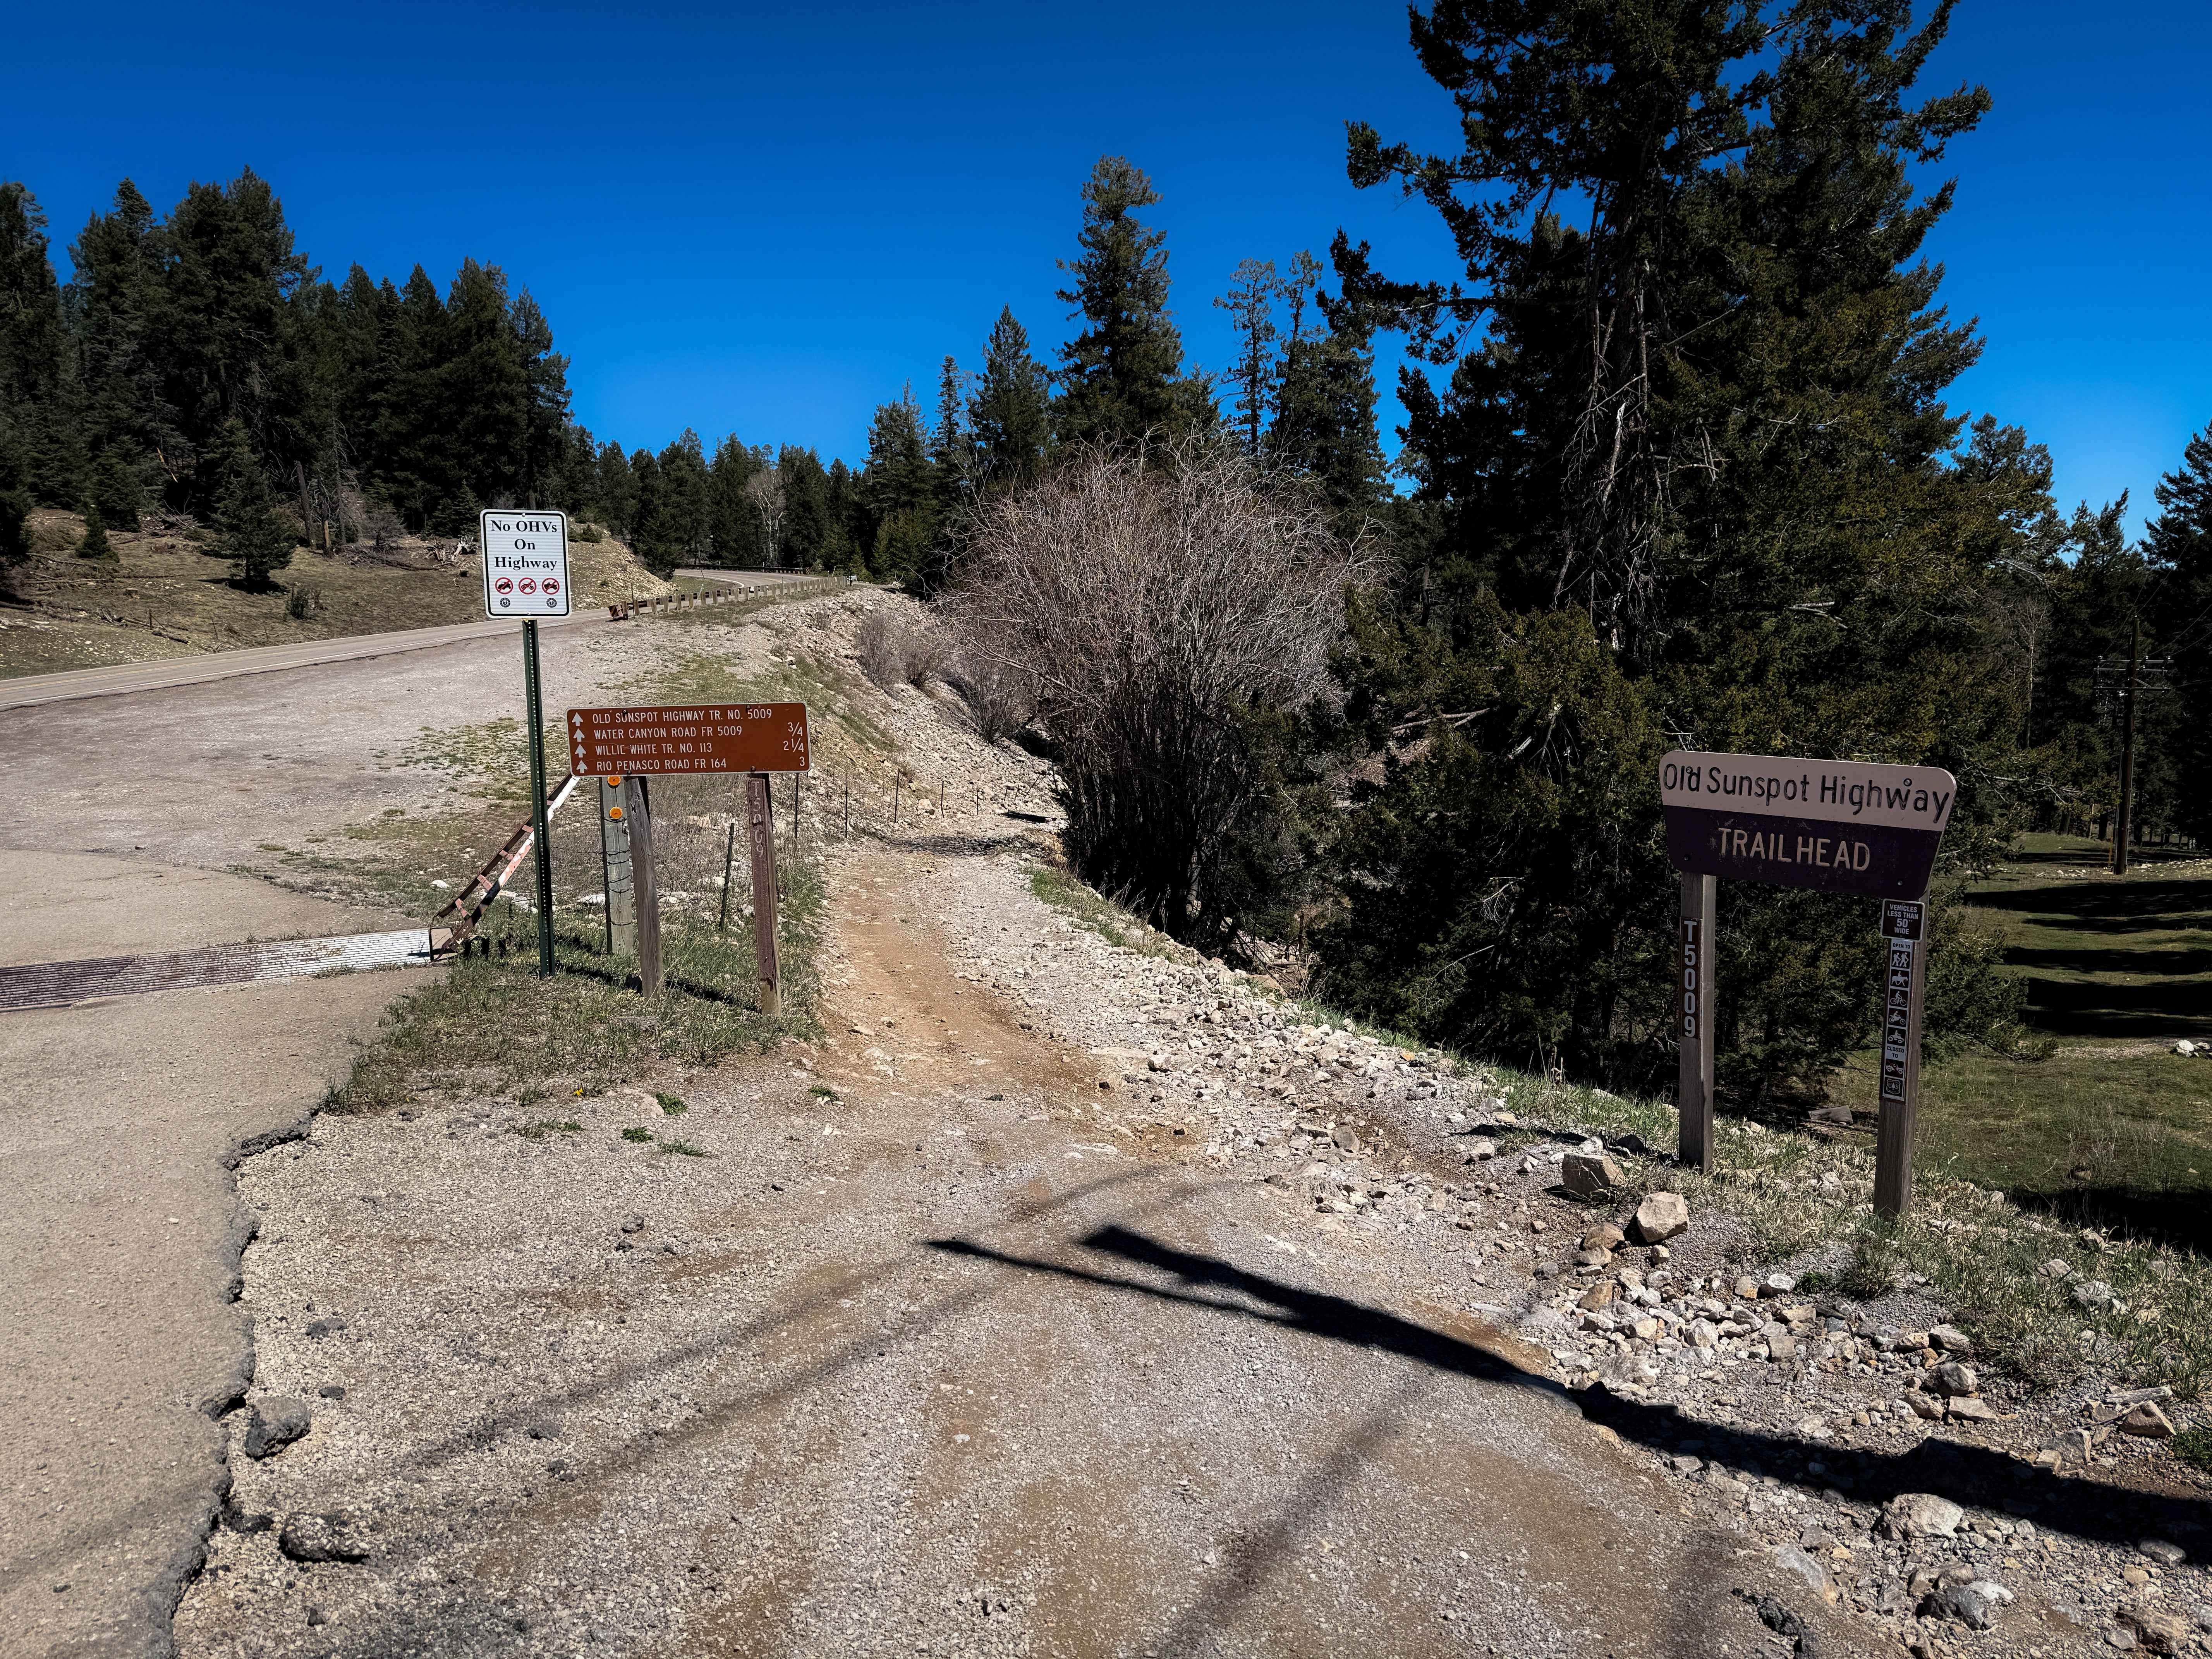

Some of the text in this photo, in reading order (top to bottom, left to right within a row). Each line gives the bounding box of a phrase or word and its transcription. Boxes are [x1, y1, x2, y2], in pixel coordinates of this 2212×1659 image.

[491, 520, 557, 532] No OHVs
[514, 539, 536, 550] On
[494, 556, 557, 571] Highway
[592, 709, 772, 724] OLD SUNSPOT HIGHWAY TR. NO. 5009
[594, 726, 742, 739] WATER CANYON ROAD FR 5009
[595, 742, 712, 756] WILLIE WHITE TR. NO. 113
[597, 758, 726, 771] RIO PENASCO ROAD FR 164
[799, 756, 805, 766] 3
[1663, 763, 1951, 824] Old Sunspot Highway
[1718, 827, 1870, 872] TRAILHEAD
[1889, 904, 1917, 913] VEHICLES
[1684, 921, 1697, 1037] T5009
